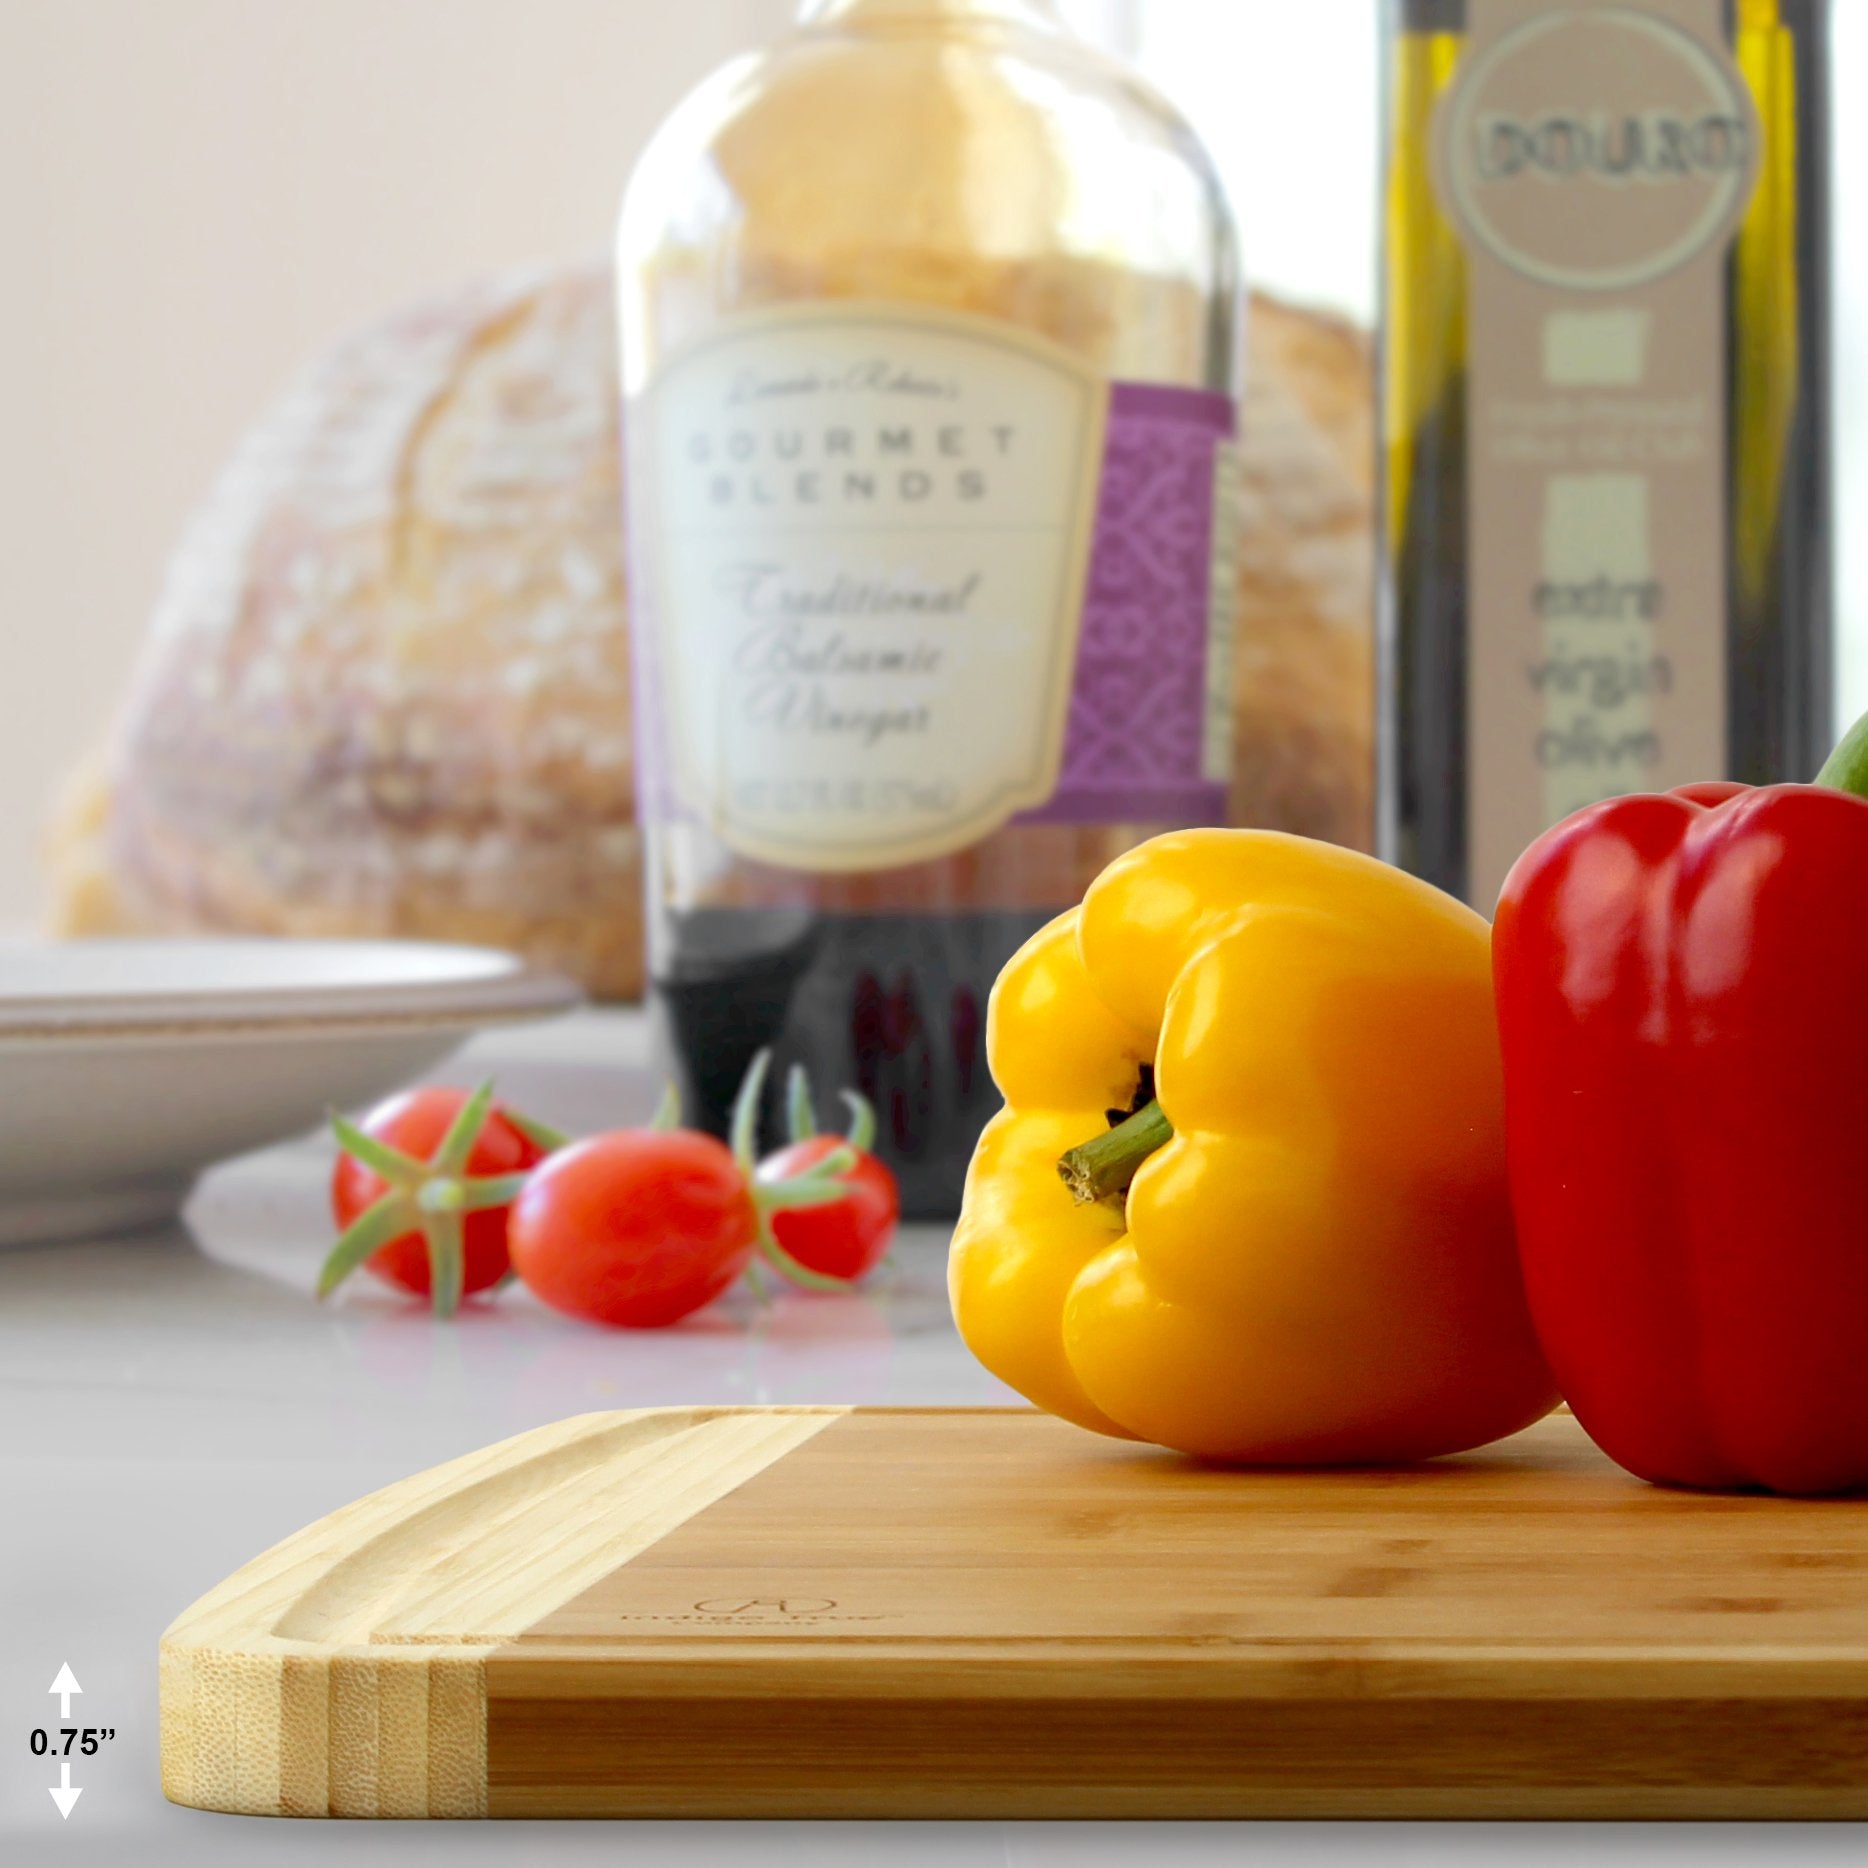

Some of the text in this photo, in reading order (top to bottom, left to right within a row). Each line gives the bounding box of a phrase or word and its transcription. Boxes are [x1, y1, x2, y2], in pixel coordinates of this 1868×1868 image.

[1475, 110, 1745, 184] DOURO
[686, 424, 1017, 464] GOURMET
[708, 467, 990, 506] BLENDS
[714, 560, 983, 618] Traditional
[1530, 575, 1665, 620] extra
[732, 620, 943, 674] Balsamic
[1525, 640, 1673, 709] virgin
[744, 676, 930, 747] Vinegar
[1534, 715, 1662, 770] olive
